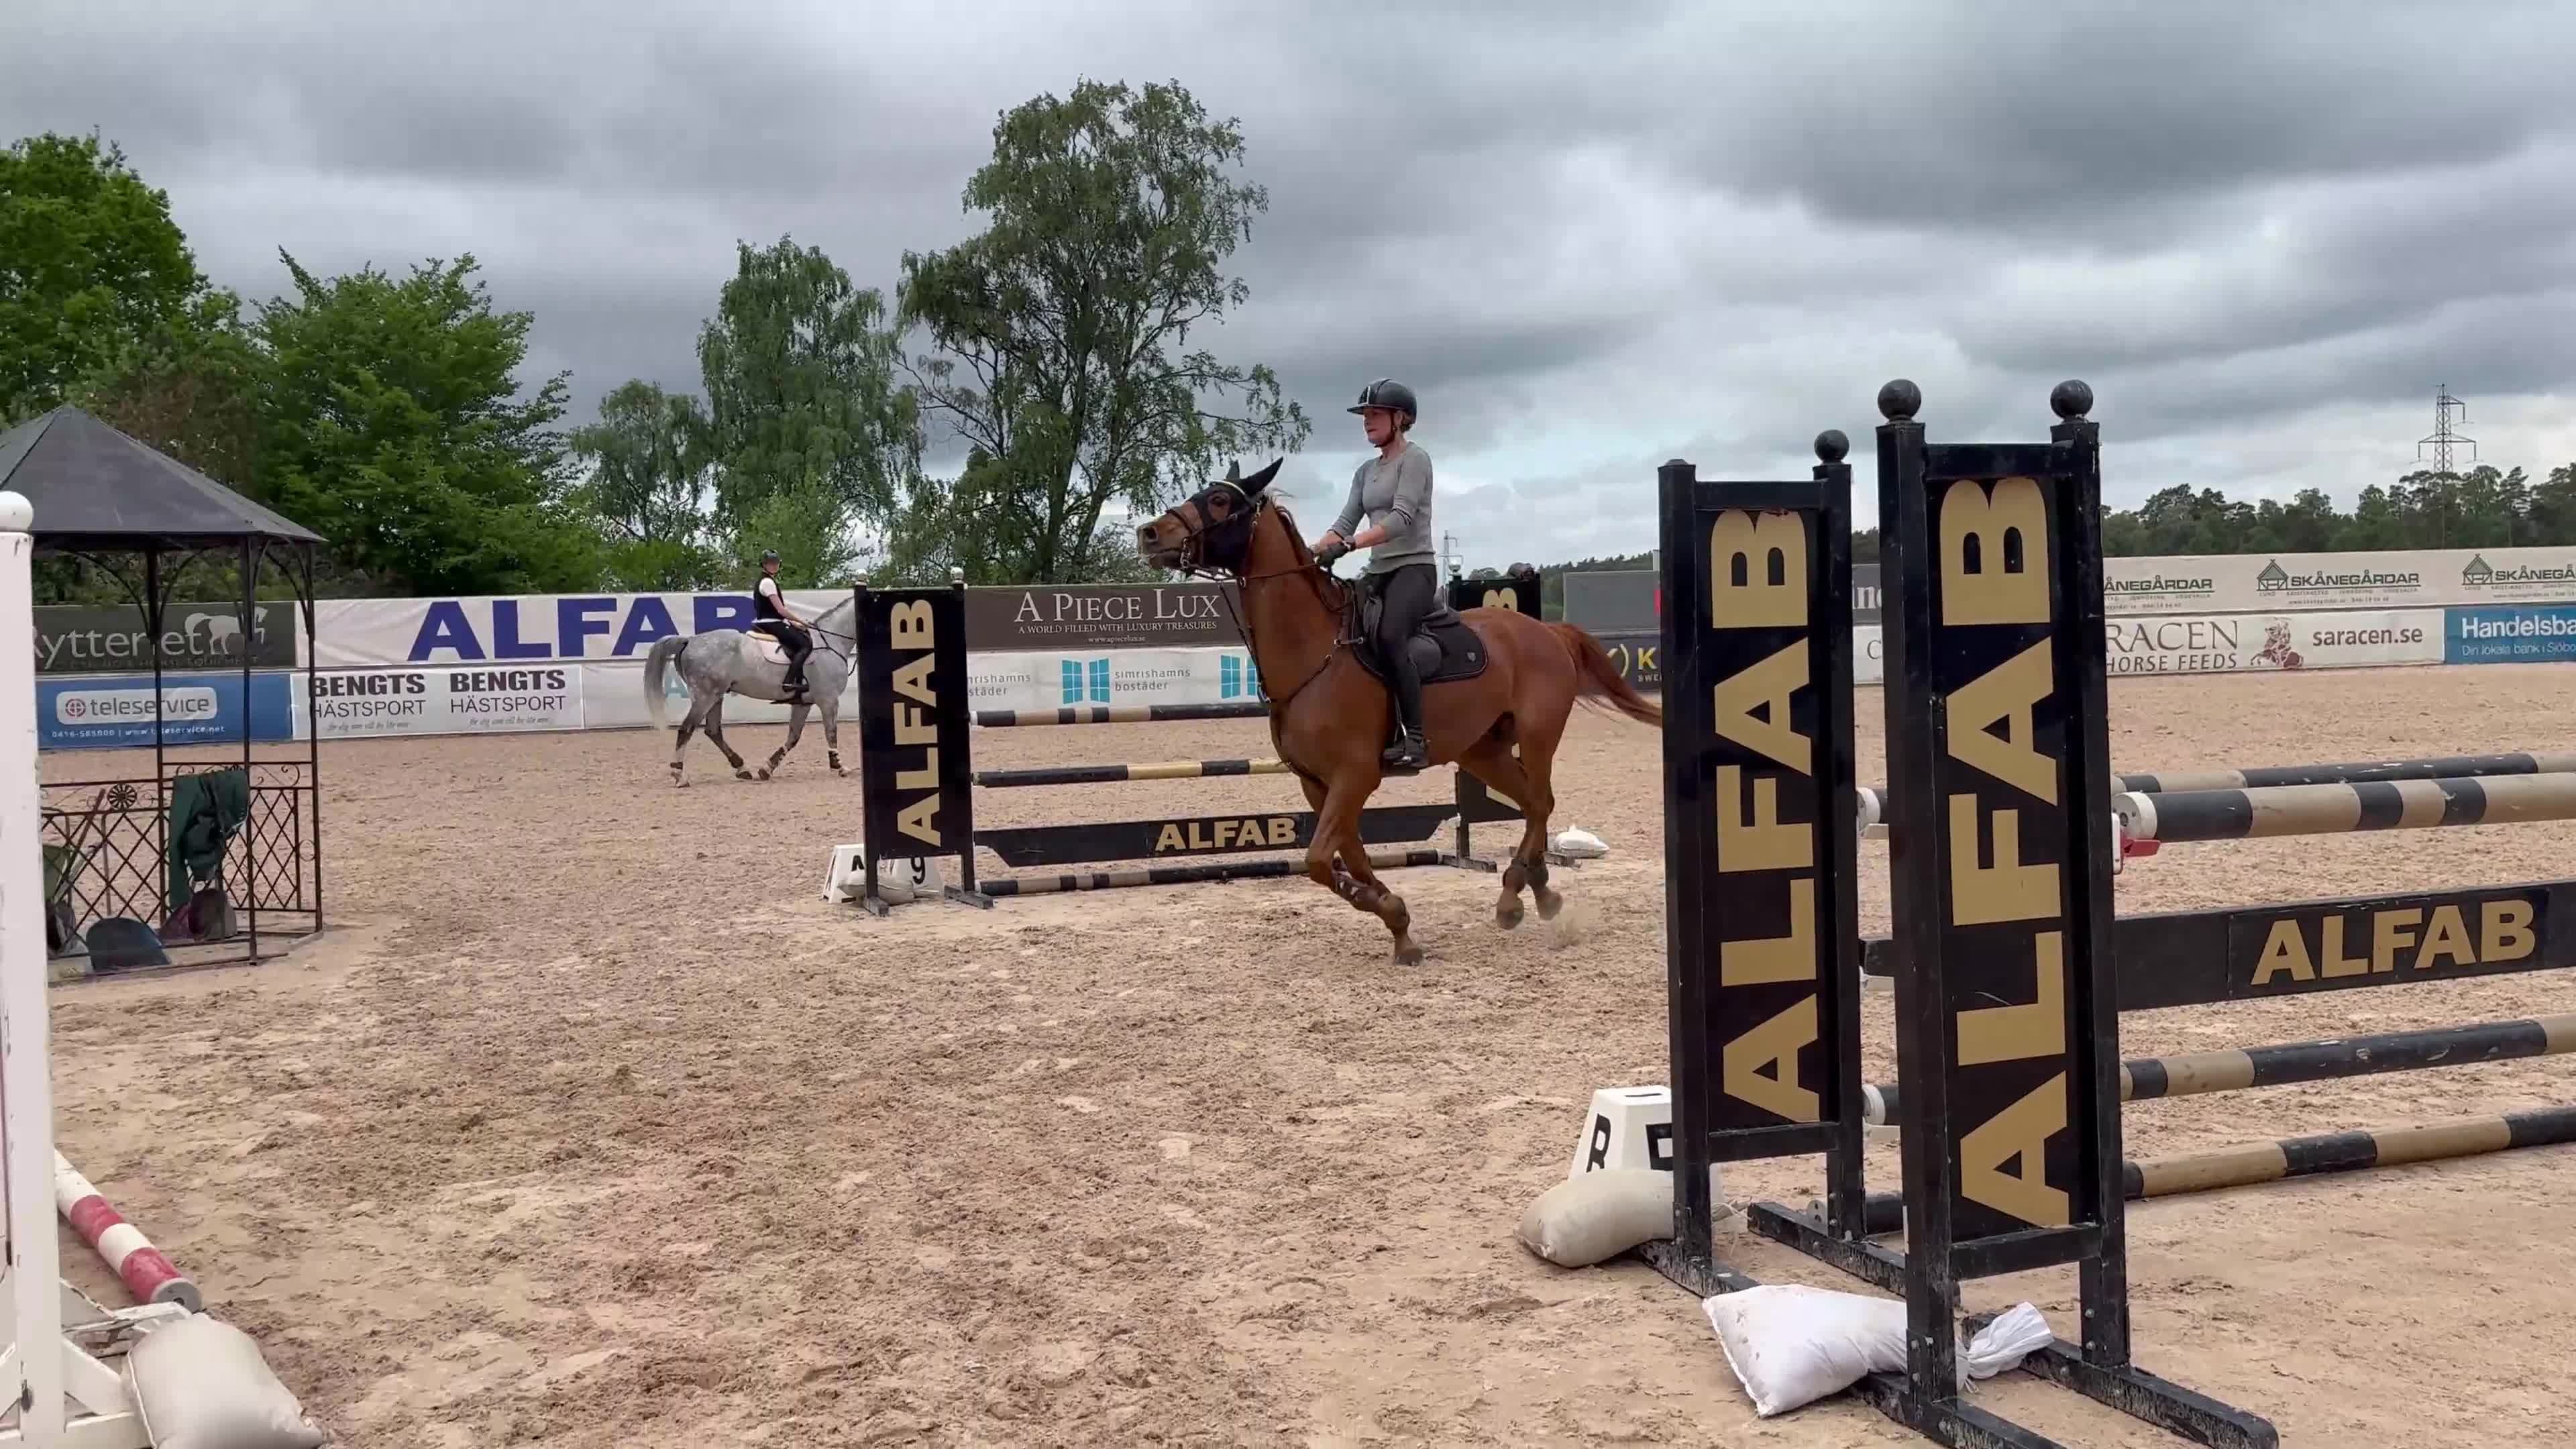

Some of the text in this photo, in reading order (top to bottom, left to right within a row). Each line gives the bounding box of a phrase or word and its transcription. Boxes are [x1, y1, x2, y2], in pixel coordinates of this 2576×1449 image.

[2291, 569, 2419, 586] SKÅNEGÅRDAR
[1014, 589, 1221, 623] A PIECE LUX
[1018, 621, 1218, 634] A WORLD FILLED WITH LUXURY TREASURES
[2312, 627, 2423, 646] saracen.se
[2514, 644, 2539, 655] bank
[2178, 653, 2237, 670] FEEDS
[450, 669, 566, 692] BENGTS
[1115, 667, 1191, 680] simrishamns
[314, 674, 425, 697] BENGTS
[1115, 681, 1169, 692] bostäder
[315, 700, 426, 718] HÄSTSPORT
[451, 695, 566, 713] HÄSTSPORT
[891, 598, 941, 847] ALFAB
[1710, 508, 1819, 1123] ALFAB
[1155, 816, 1297, 852] ALFAB
[1939, 476, 2069, 1227] ALFAB
[2251, 899, 2536, 985] ALFAB
[1586, 1113, 1611, 1173] R
